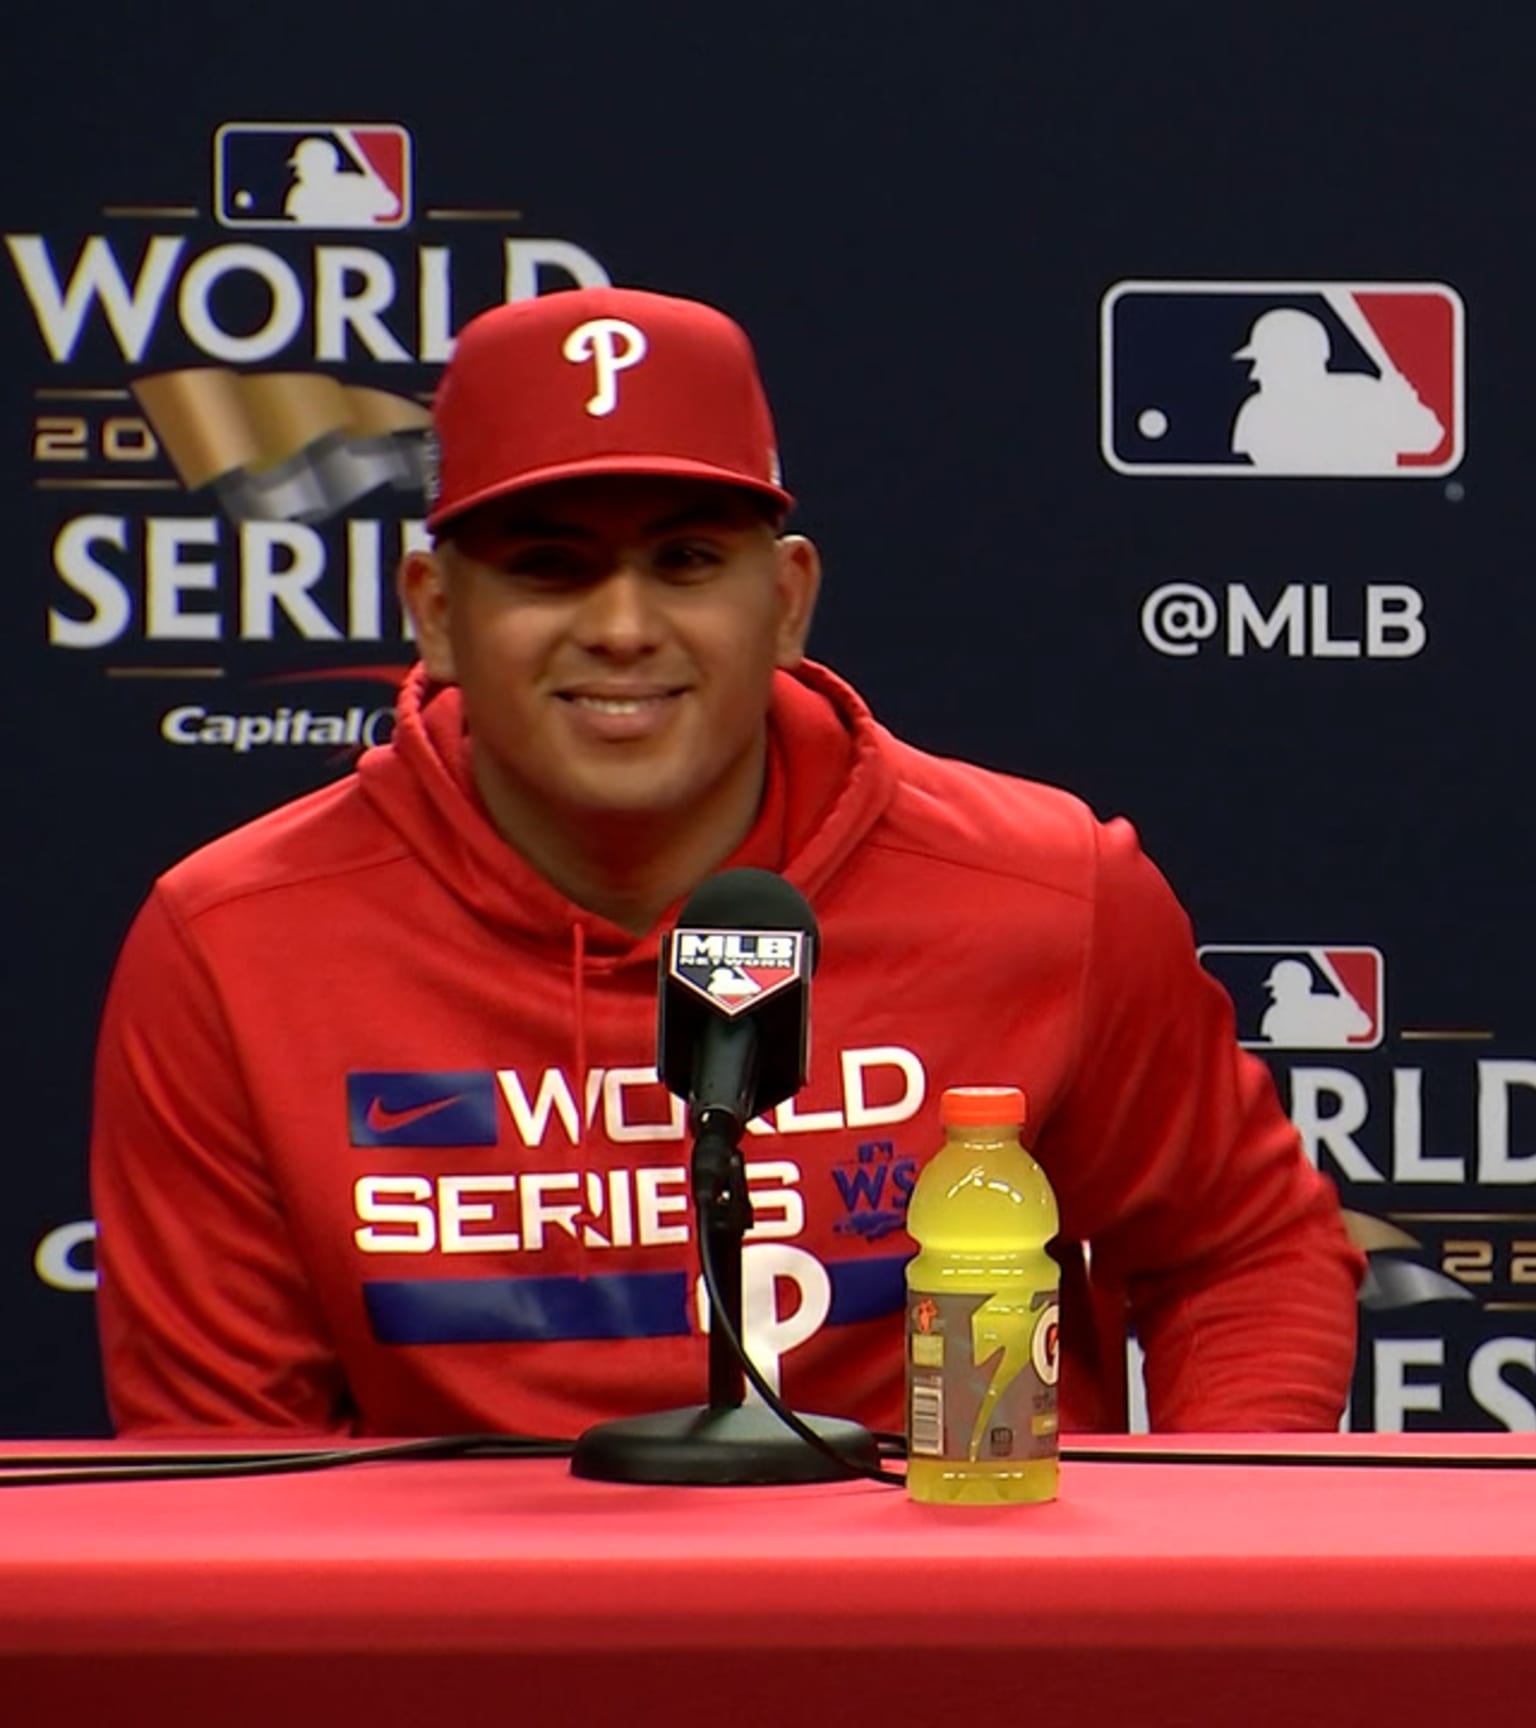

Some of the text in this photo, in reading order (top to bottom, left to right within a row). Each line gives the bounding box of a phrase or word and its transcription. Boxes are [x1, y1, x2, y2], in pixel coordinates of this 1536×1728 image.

[563, 318, 647, 416] P
[1141, 582, 1428, 658] @MLB
[681, 934, 794, 959] MLB
[354, 1160, 804, 1253] SERIES
